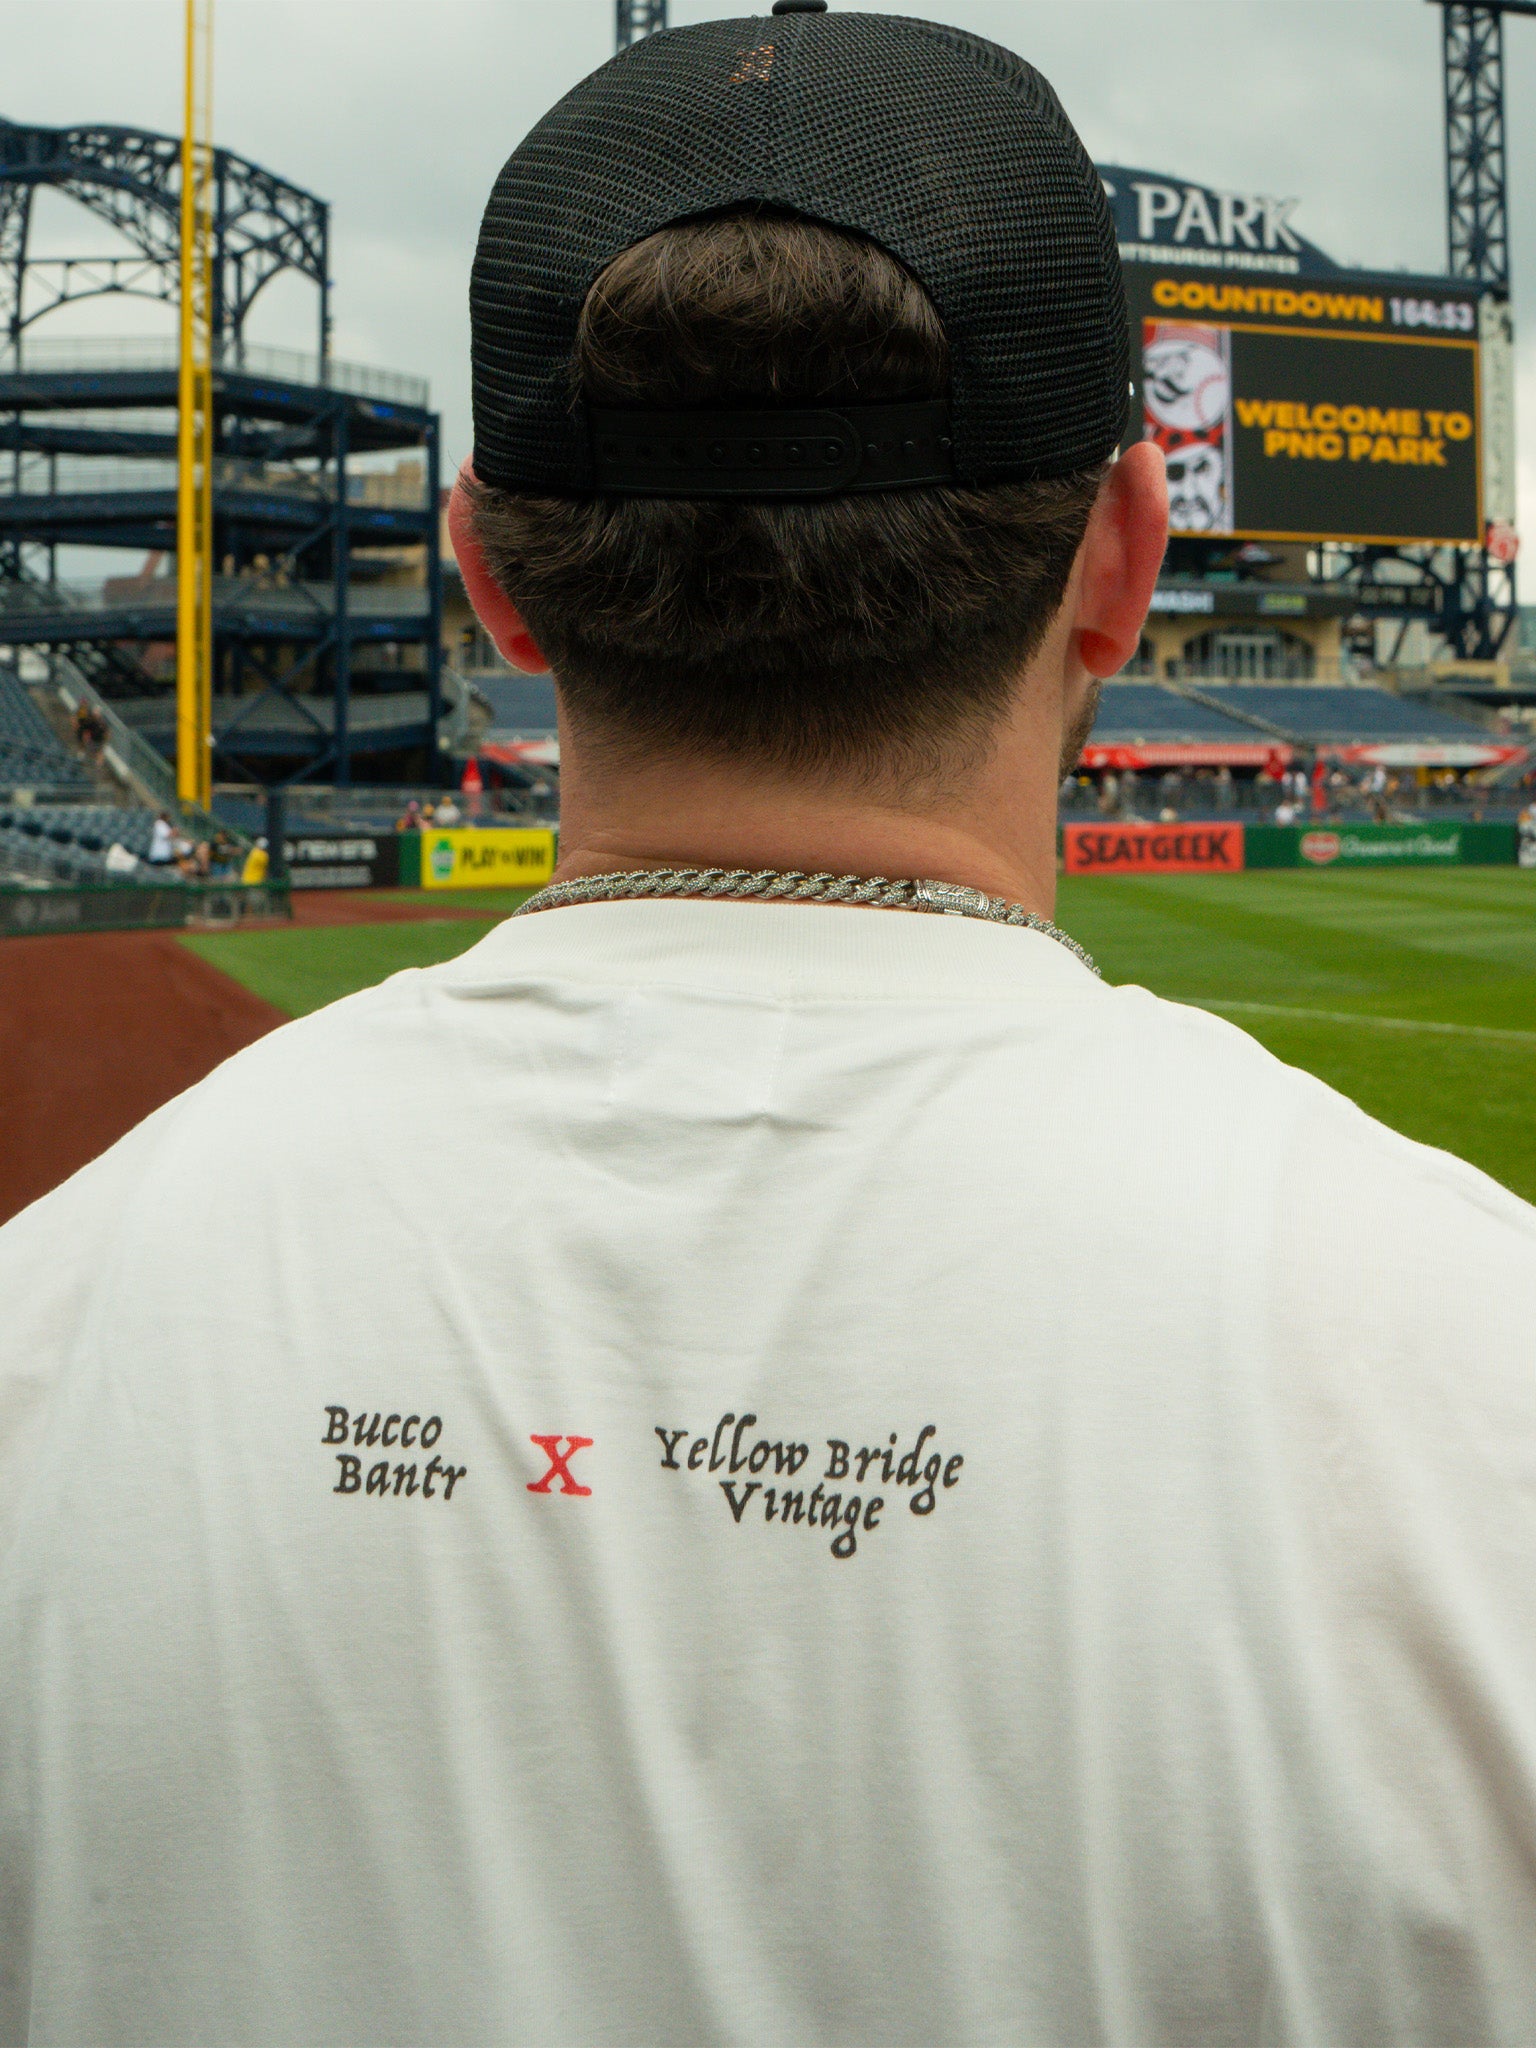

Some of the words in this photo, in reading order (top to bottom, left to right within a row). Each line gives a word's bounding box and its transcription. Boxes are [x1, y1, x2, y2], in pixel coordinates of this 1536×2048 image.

[1132, 183, 1301, 251] PARK
[1152, 279, 1384, 324] COUNTDOWN
[1234, 399, 1421, 437] WELCOME
[1424, 411, 1473, 440] TO
[1264, 429, 1344, 461] PNC
[1349, 433, 1447, 467] PARK
[1076, 830, 1230, 866] SEATGEEK
[321, 1405, 443, 1449] Bucco
[333, 1454, 467, 1500] Bantr
[526, 1433, 594, 1496] X
[654, 1412, 809, 1475] Yellow
[823, 1424, 964, 1516] Bridge
[719, 1480, 884, 1559] Vintage
